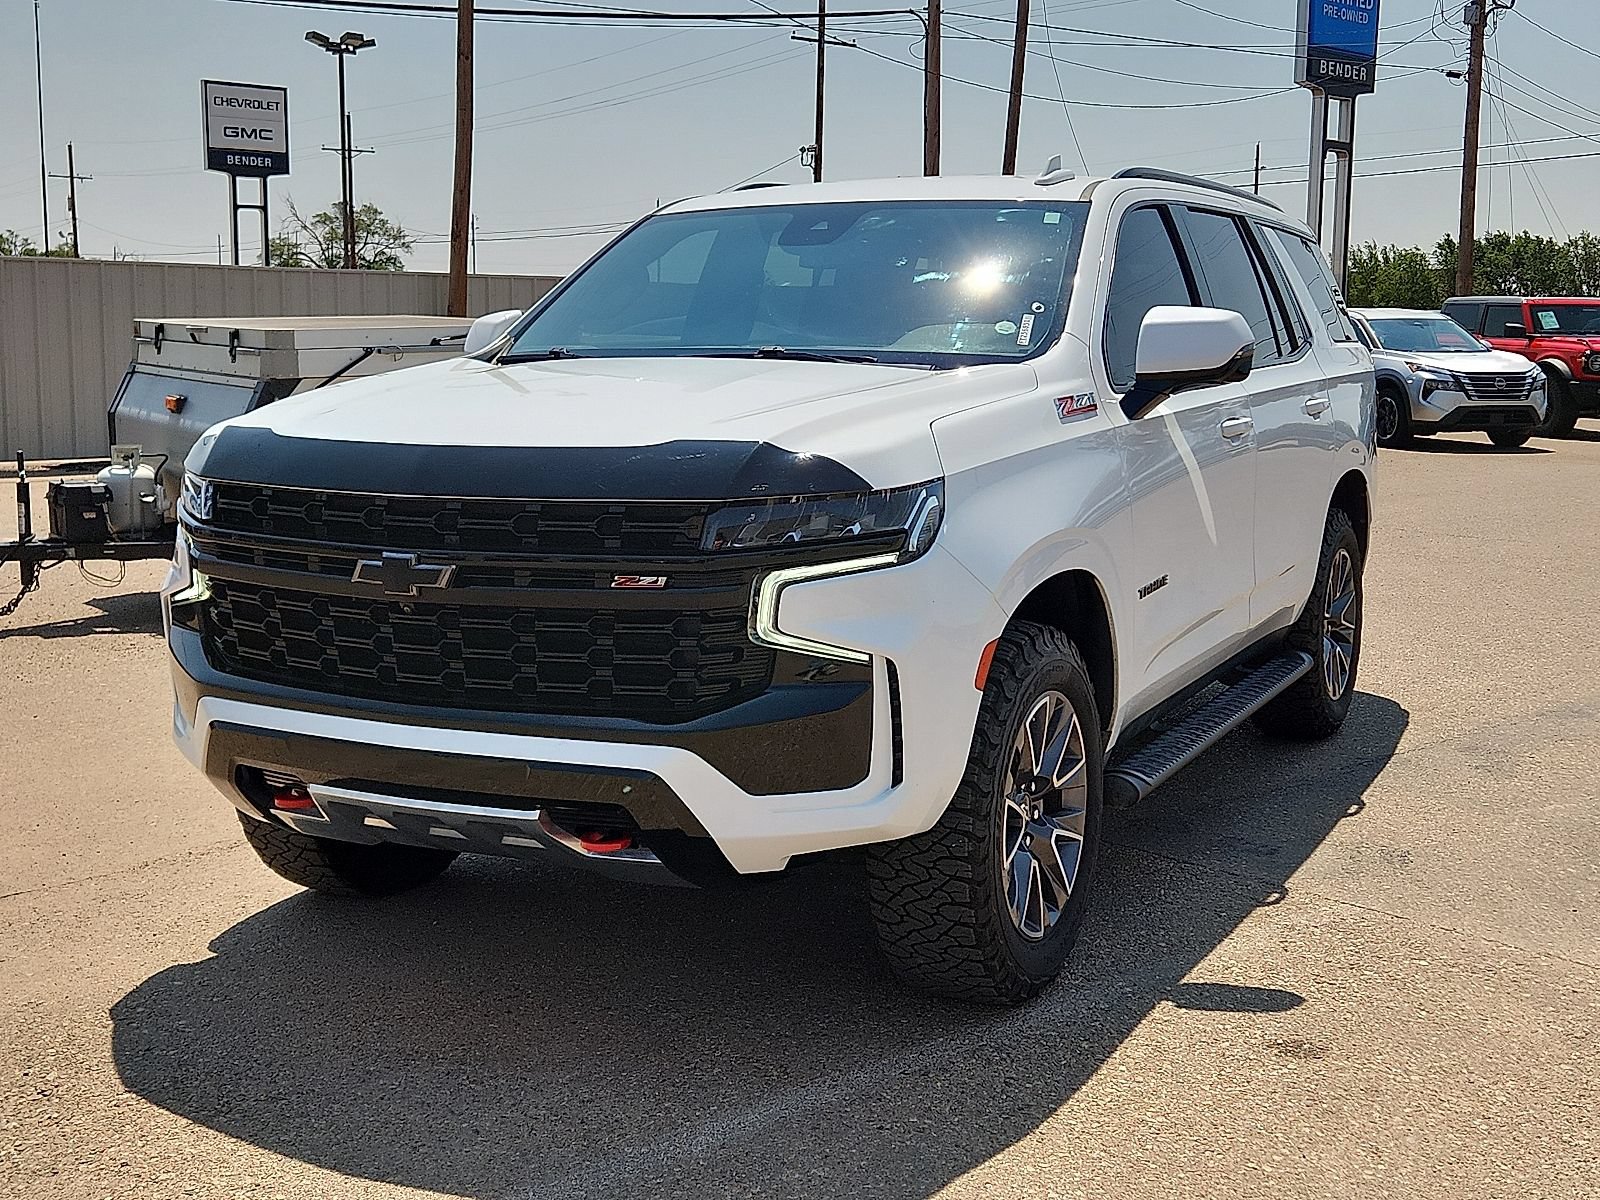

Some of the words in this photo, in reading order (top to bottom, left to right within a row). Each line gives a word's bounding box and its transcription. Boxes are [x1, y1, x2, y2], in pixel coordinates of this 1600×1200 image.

[1323, 4, 1369, 24] PRE-OWNED
[1319, 60, 1367, 81] BENDER
[213, 96, 281, 112] CHEVROLET
[223, 126, 274, 141] GMC
[226, 154, 272, 168] BENDER
[610, 575, 668, 588] Z71
[1137, 574, 1169, 600] TAHOE
